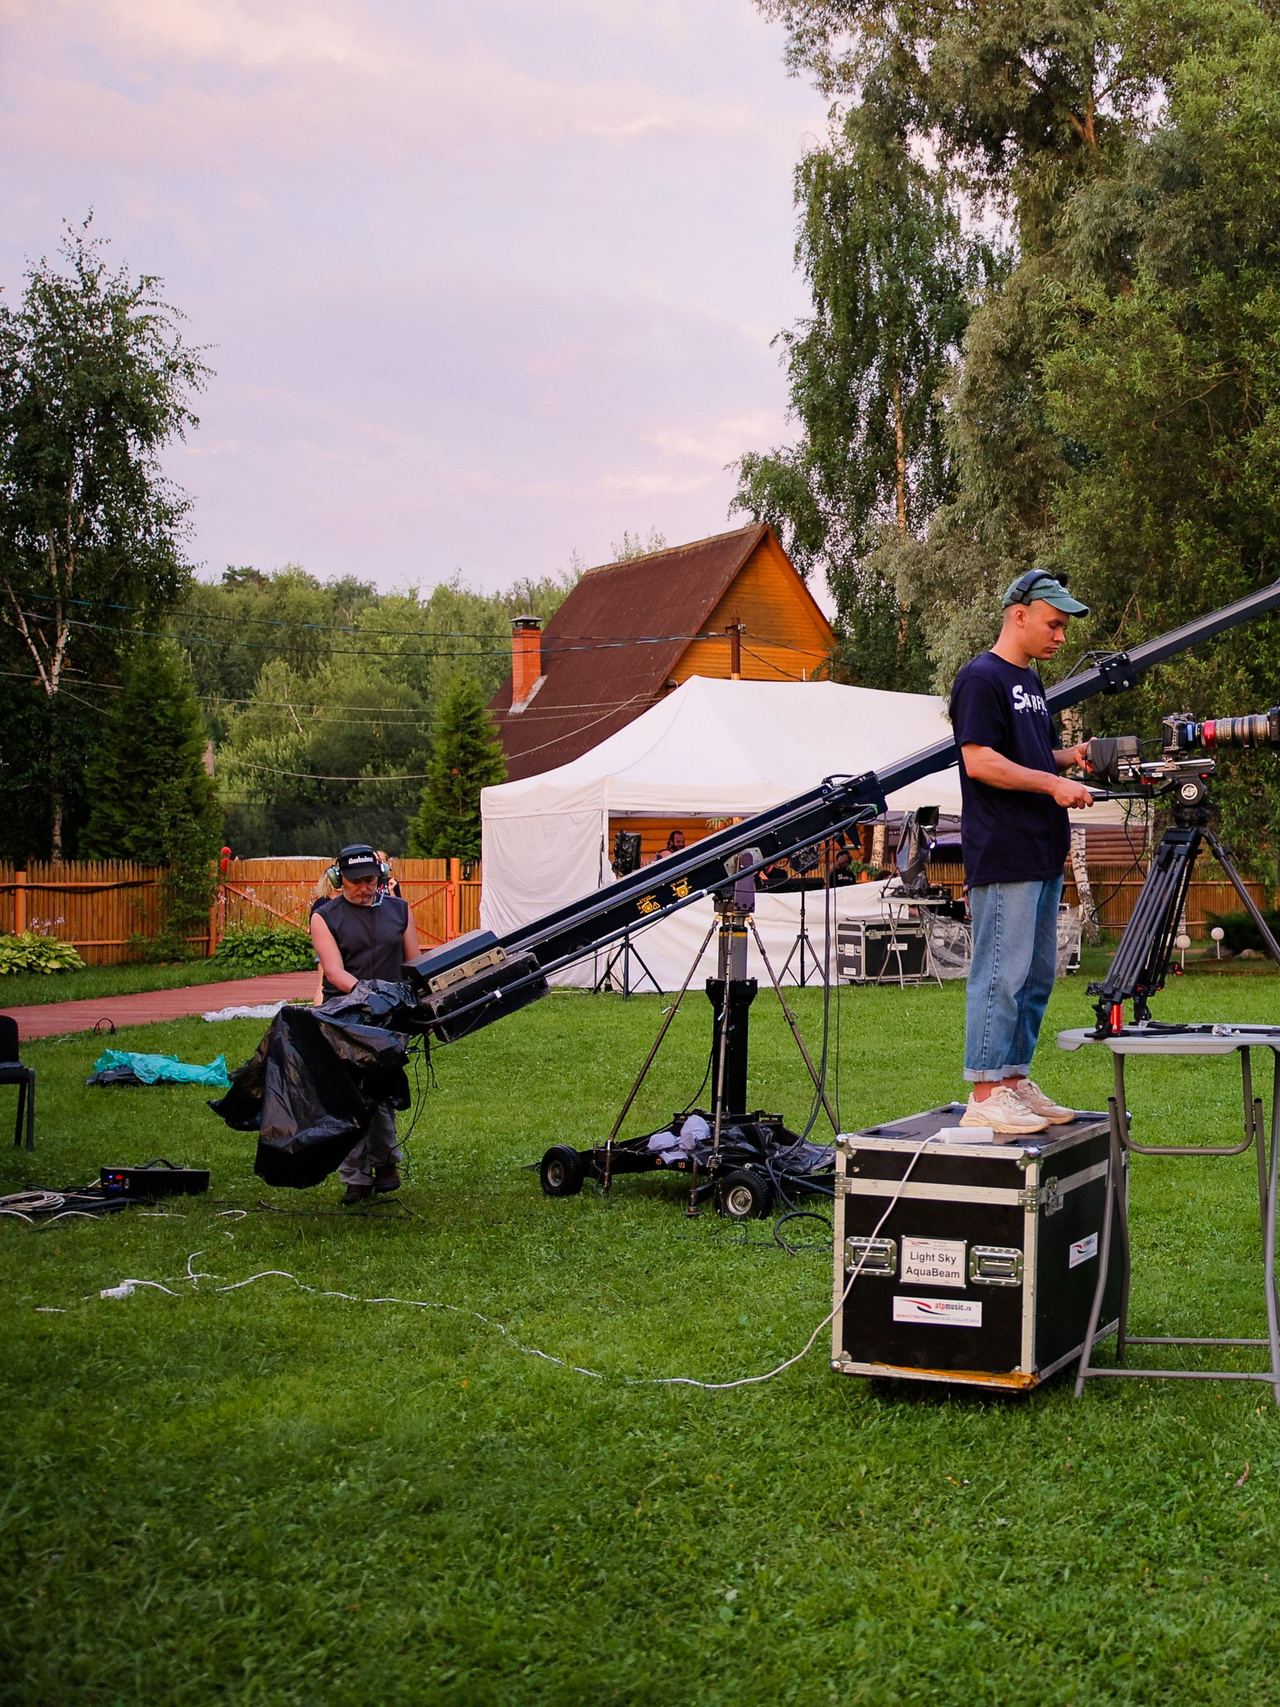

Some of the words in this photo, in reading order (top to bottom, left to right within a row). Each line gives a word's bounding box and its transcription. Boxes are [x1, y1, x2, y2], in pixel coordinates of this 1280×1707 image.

[910, 1251, 935, 1263] Light
[938, 1253, 957, 1265] Sky
[906, 1266, 960, 1278] AquaBeam
[935, 1302, 972, 1311] atpmusic.ru
